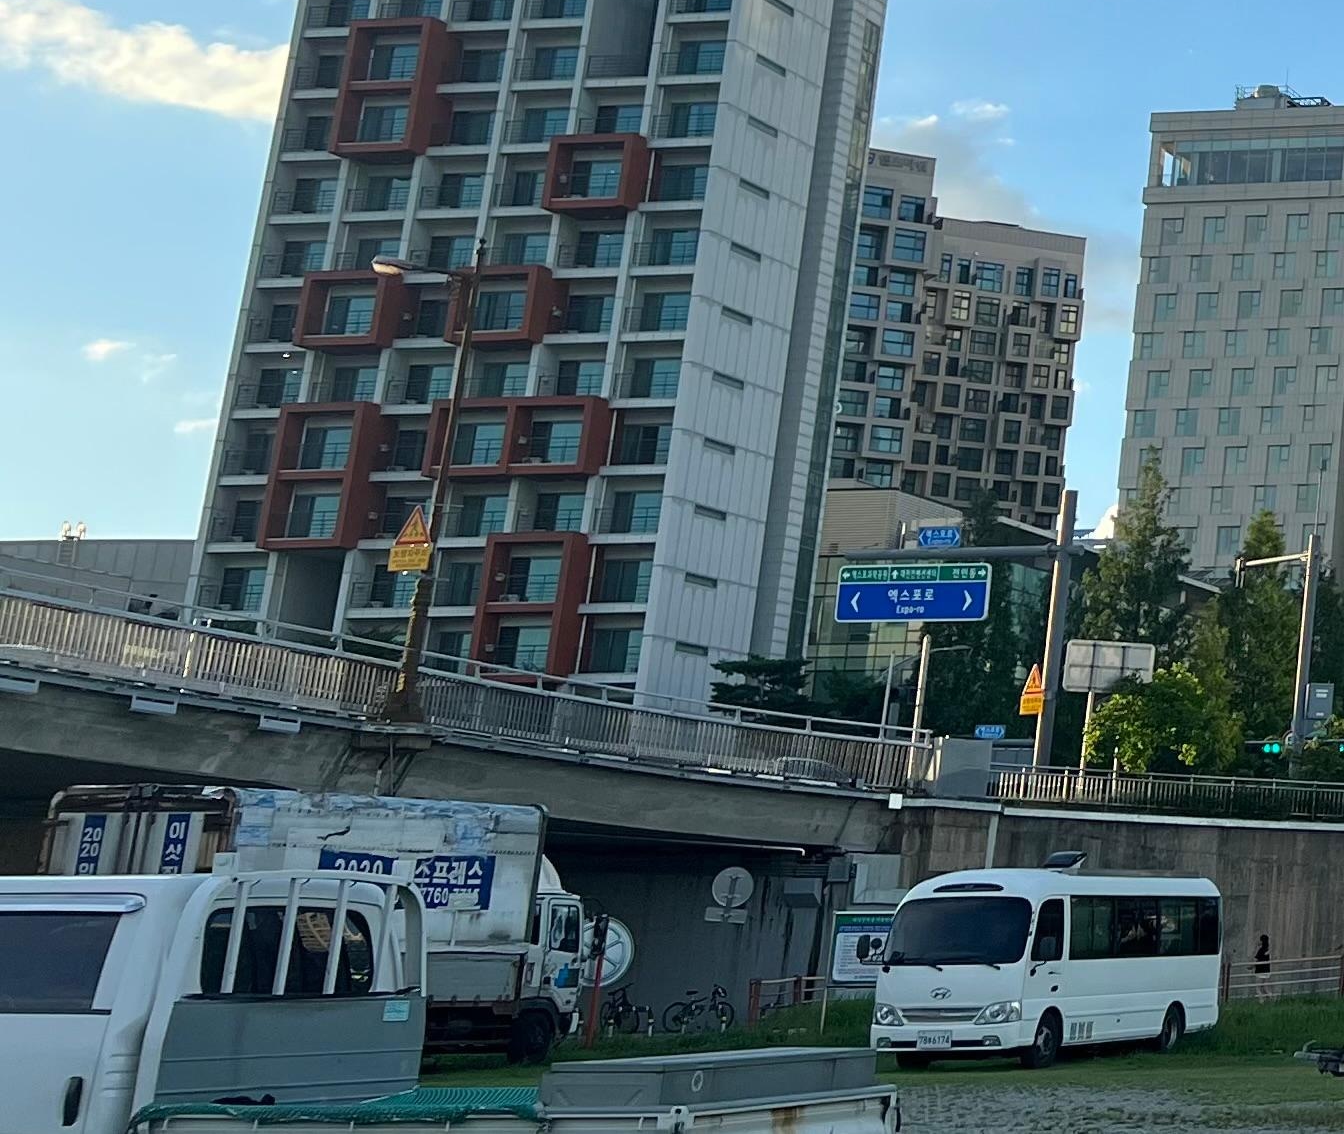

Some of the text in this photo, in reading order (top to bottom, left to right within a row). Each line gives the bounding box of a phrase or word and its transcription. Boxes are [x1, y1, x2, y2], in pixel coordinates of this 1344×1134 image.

[888, 588, 934, 604] 엑스포로
[895, 604, 925, 615] Expo-ro
[391, 860, 483, 885] 스프레스
